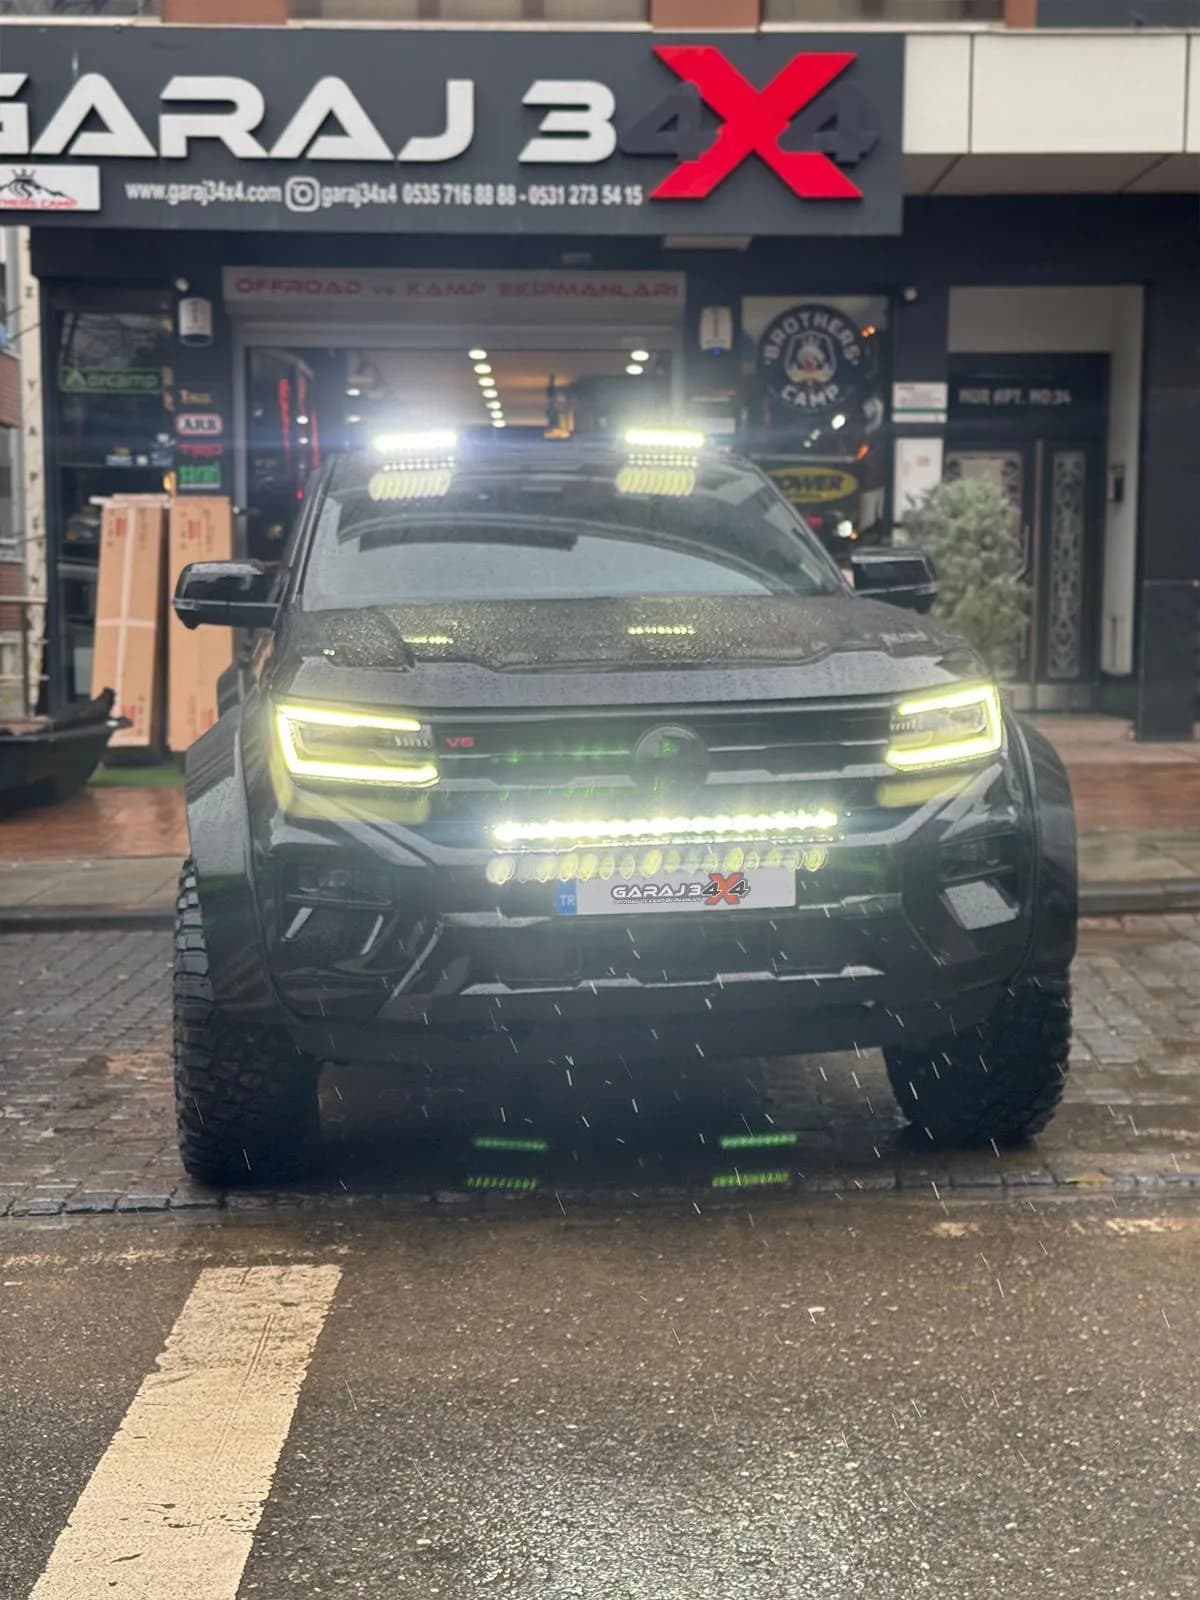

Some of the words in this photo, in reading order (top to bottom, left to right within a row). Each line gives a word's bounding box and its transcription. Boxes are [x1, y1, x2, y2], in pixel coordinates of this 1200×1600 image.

[0, 72, 475, 162] ARAJ
[125, 180, 282, 206] www.garaj34x4.com
[322, 181, 397, 207] garaj34x4
[403, 183, 440, 205] 0535
[443, 184, 472, 205] 716
[474, 184, 494, 205] 88
[496, 184, 516, 205] 88
[528, 184, 565, 206] 0531
[569, 185, 598, 206] 273
[602, 186, 622, 206] 54
[624, 186, 643, 206] 15
[235, 278, 361, 295] OFFROAD
[407, 281, 486, 297] KAMP
[764, 311, 860, 360] BROTHERS
[782, 383, 839, 408] CAMP
[445, 736, 475, 748] V6
[560, 895, 575, 906] TR
[612, 883, 687, 899] GARAJ
